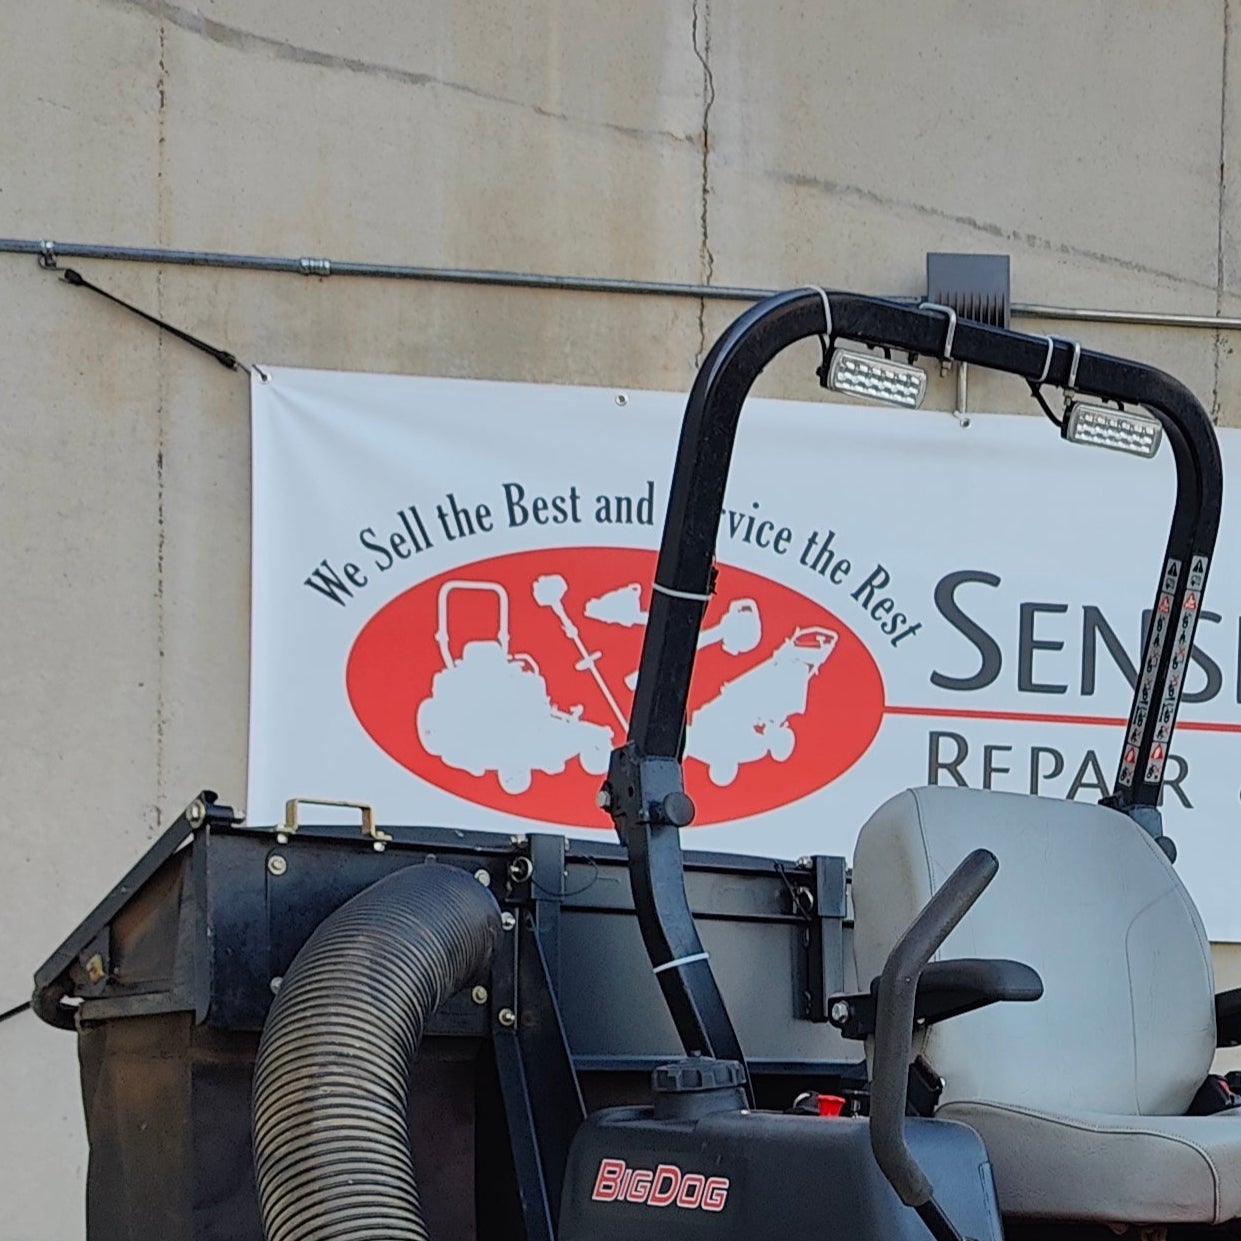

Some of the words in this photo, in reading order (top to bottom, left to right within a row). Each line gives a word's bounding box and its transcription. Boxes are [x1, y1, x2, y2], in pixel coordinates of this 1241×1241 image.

[304, 560, 368, 607] We
[359, 506, 434, 572] Sell
[436, 493, 494, 541] the
[502, 482, 582, 528] Best
[595, 481, 655, 526] and
[721, 502, 792, 554] vice
[799, 530, 852, 585] the
[850, 563, 922, 648] Rest
[927, 730, 1194, 809] REPAR
[592, 1158, 729, 1211] BIGDOG
